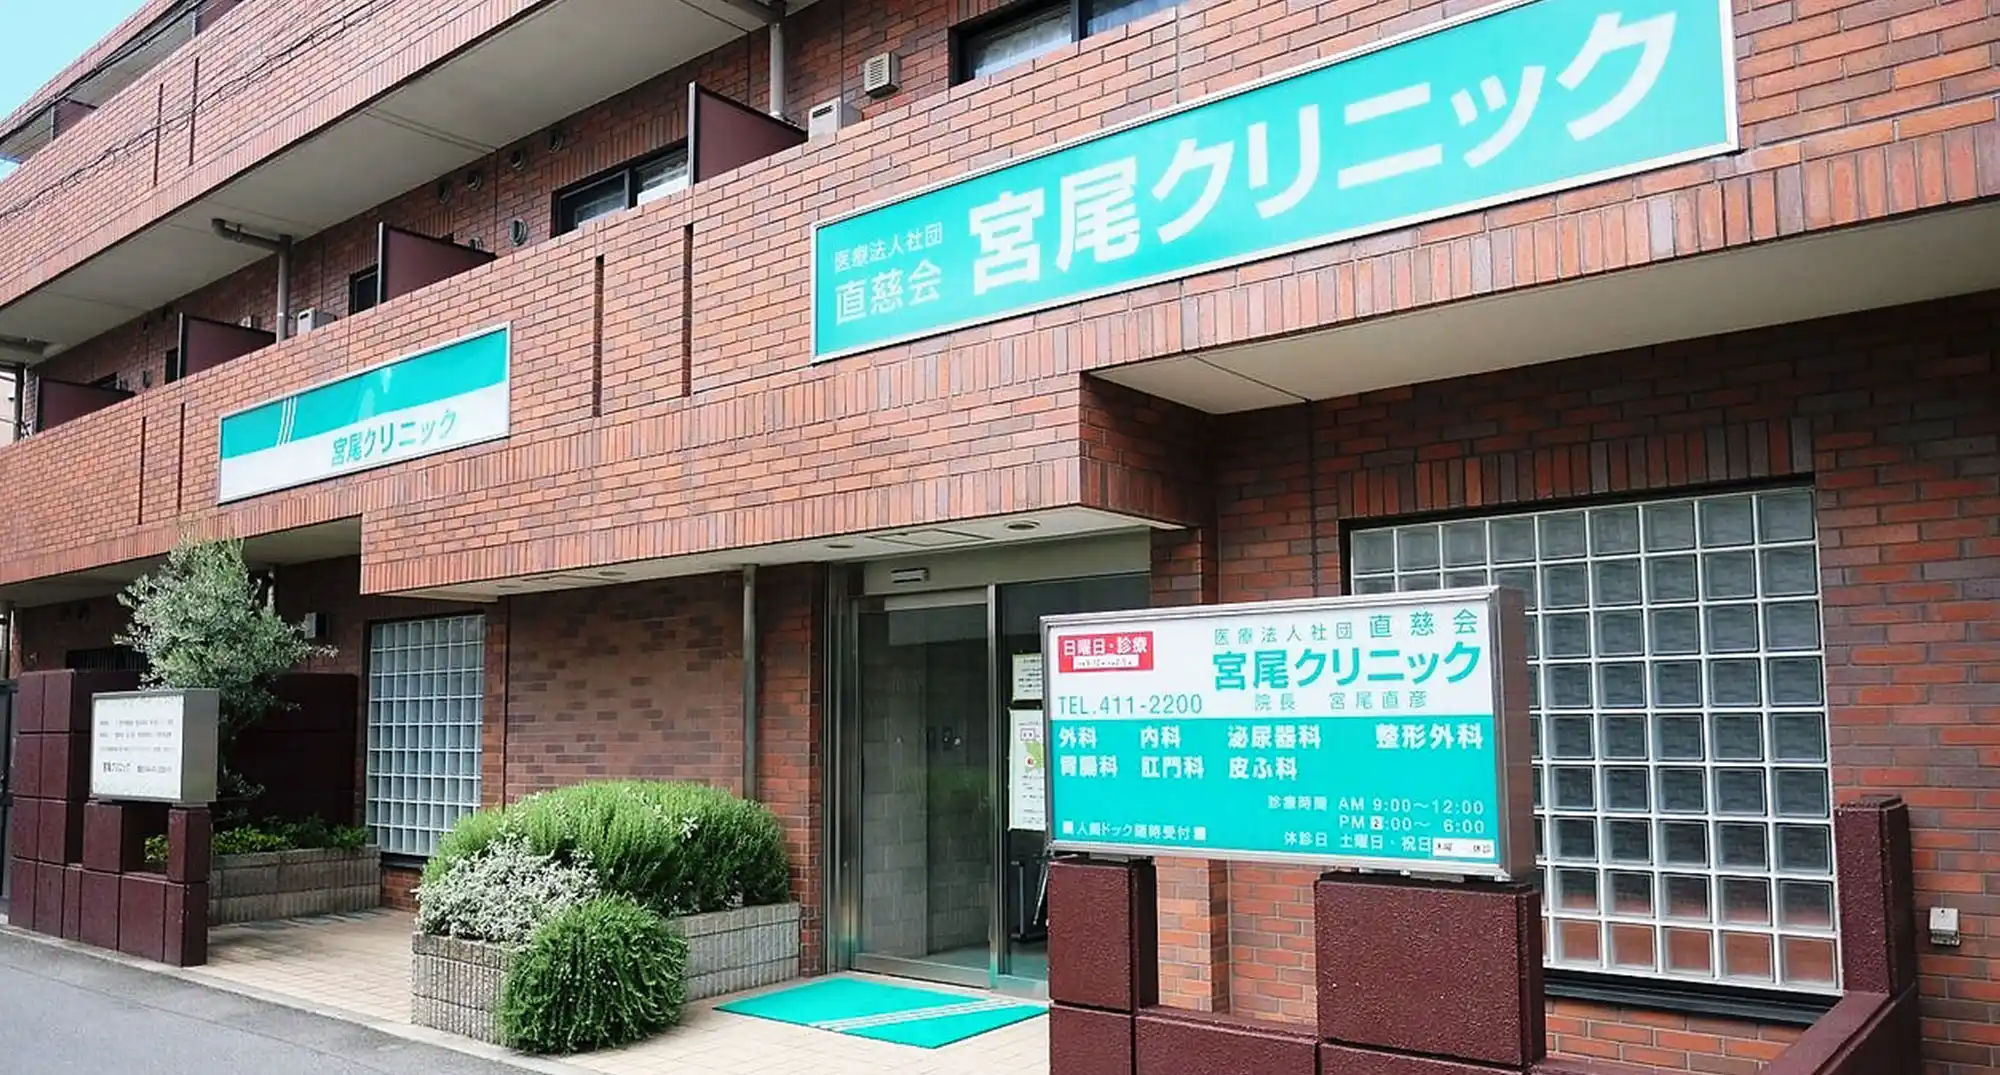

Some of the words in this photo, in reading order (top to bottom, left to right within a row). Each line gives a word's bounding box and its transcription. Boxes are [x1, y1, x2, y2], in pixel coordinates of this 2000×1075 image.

[968, 11, 1677, 296] 宮尾クリニック
[834, 222, 943, 273] 医療法人社団
[835, 259, 942, 325] 直慈会
[331, 408, 458, 467] 宮尾クリニック
[1213, 622, 1353, 646] 医療法人社団
[1369, 608, 1478, 638] 直慈会
[1212, 641, 1482, 692] 宮尾クリニック
[1058, 693, 1203, 715] TEL.411-2200
[1254, 692, 1296, 711] 院長
[1329, 690, 1428, 711] 宮尾直彦
[1059, 725, 1097, 749] 外科
[1140, 724, 1181, 749] 内科
[1227, 723, 1322, 749] 泌尿器科
[1375, 722, 1483, 750] 整形外科
[1141, 755, 1204, 779] 肛門科
[1228, 756, 1298, 781] 皮ふ科
[1338, 797, 1365, 812] AM
[1339, 816, 1365, 831] PM
[1443, 818, 1484, 835] 6:00
